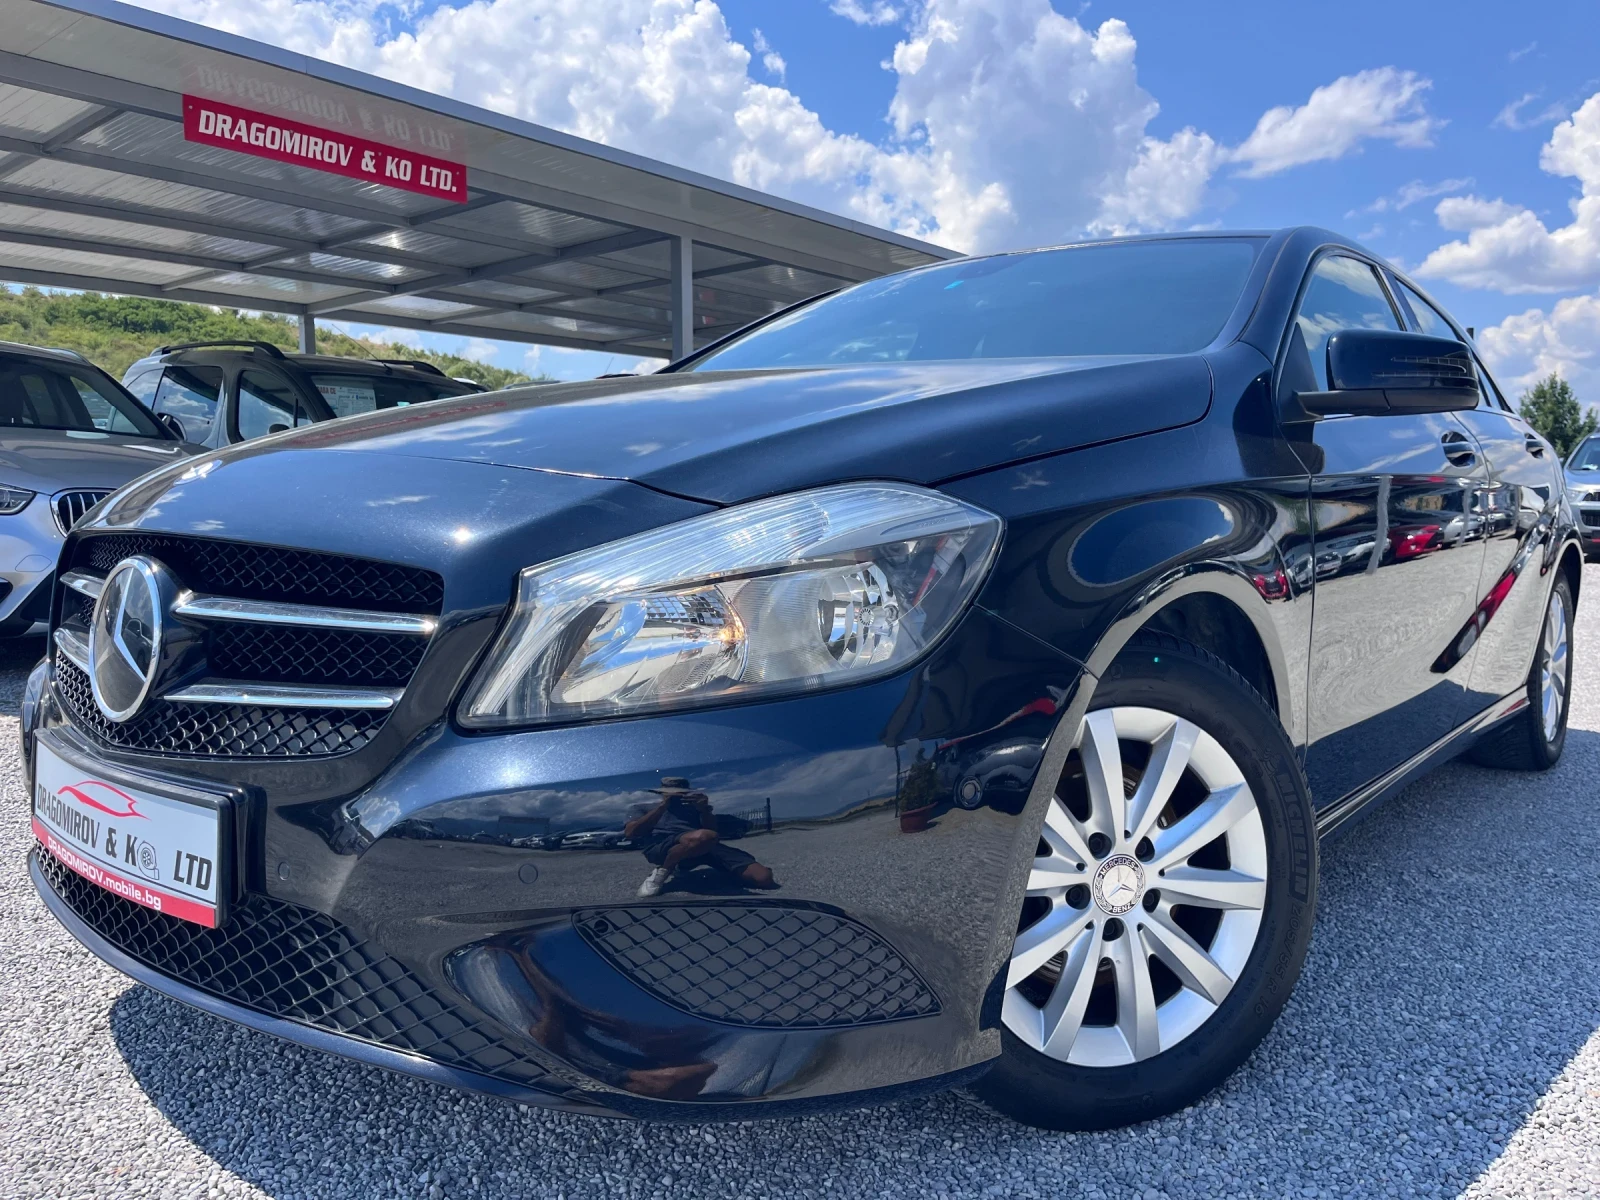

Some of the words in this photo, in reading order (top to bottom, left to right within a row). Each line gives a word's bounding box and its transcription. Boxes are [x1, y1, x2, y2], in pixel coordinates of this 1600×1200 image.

[198, 109, 353, 167] DRAGOMIROV
[361, 150, 377, 174] &
[385, 155, 413, 182] KO
[420, 164, 457, 193] LTD.
[36, 783, 101, 850] DRAGOMIROV
[105, 827, 118, 859] &
[173, 850, 213, 891] LTD
[47, 836, 162, 911] DRAGOMIROV.mobile.bg
[1100, 857, 1137, 876] MERCEDES
[1277, 773, 1308, 896] MICHELIN
[1112, 903, 1133, 913] BENZ
